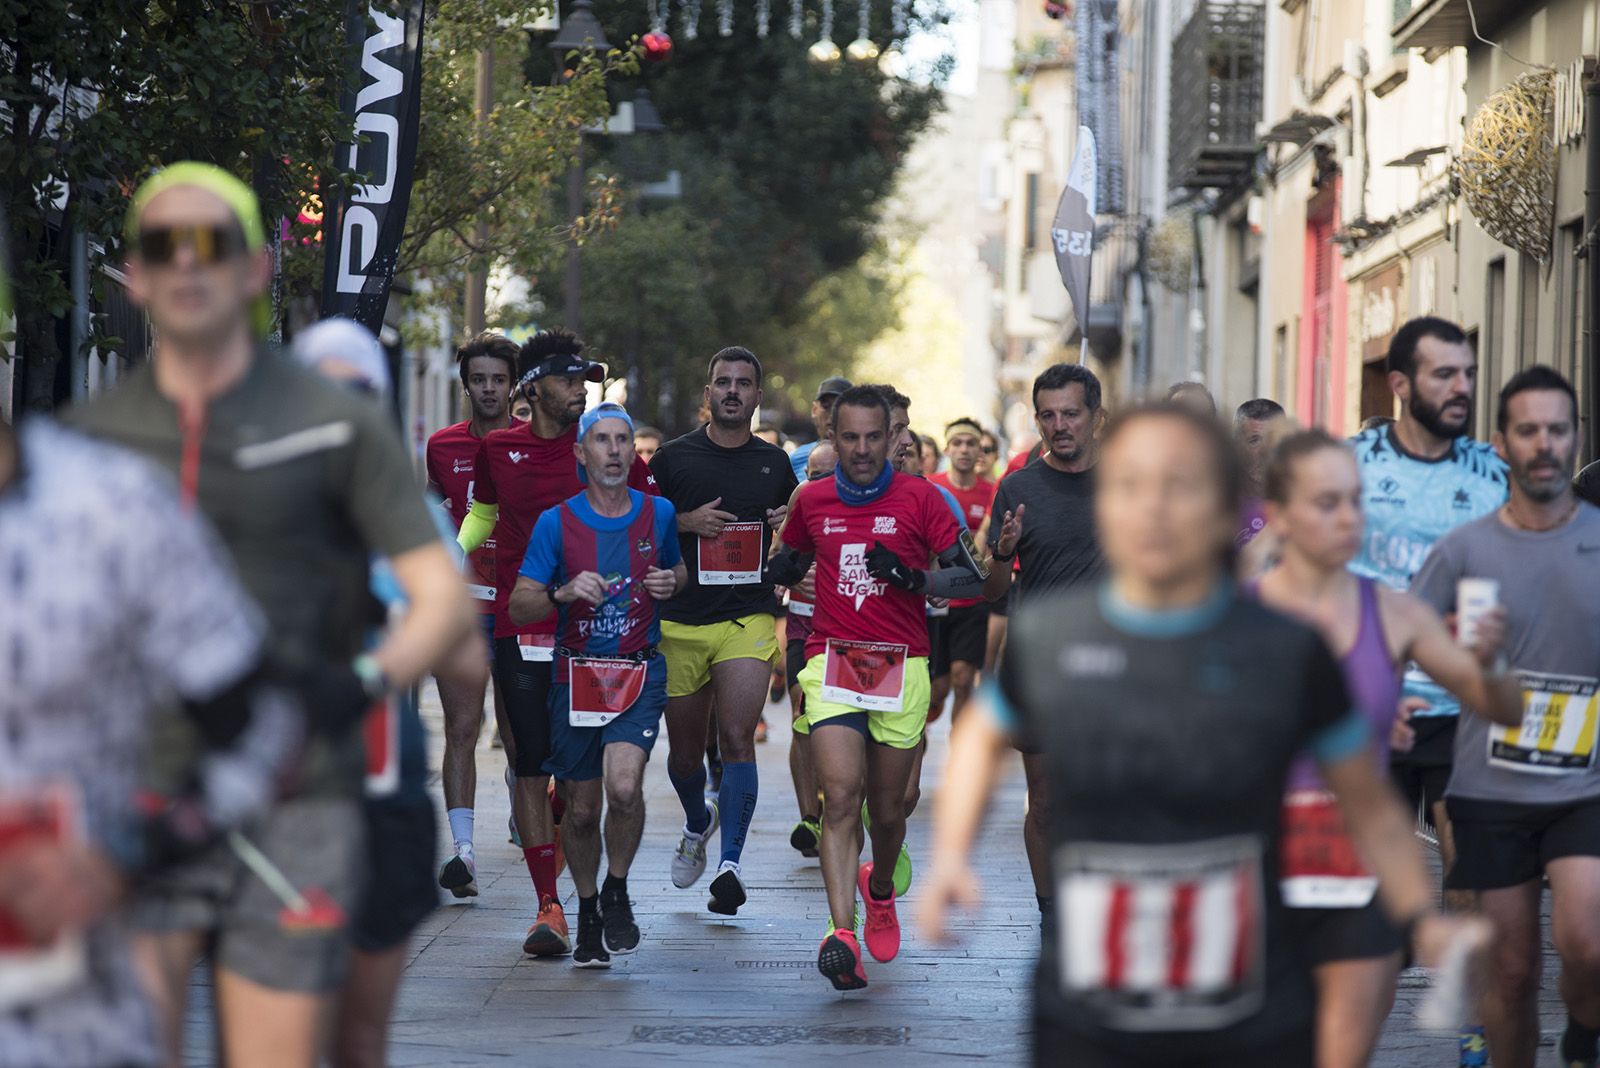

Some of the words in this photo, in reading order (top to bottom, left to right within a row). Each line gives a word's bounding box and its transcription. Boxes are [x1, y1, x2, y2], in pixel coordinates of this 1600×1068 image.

[727, 551, 742, 564] 400
[840, 569, 871, 581] SAN
[837, 582, 888, 597] CUGAT
